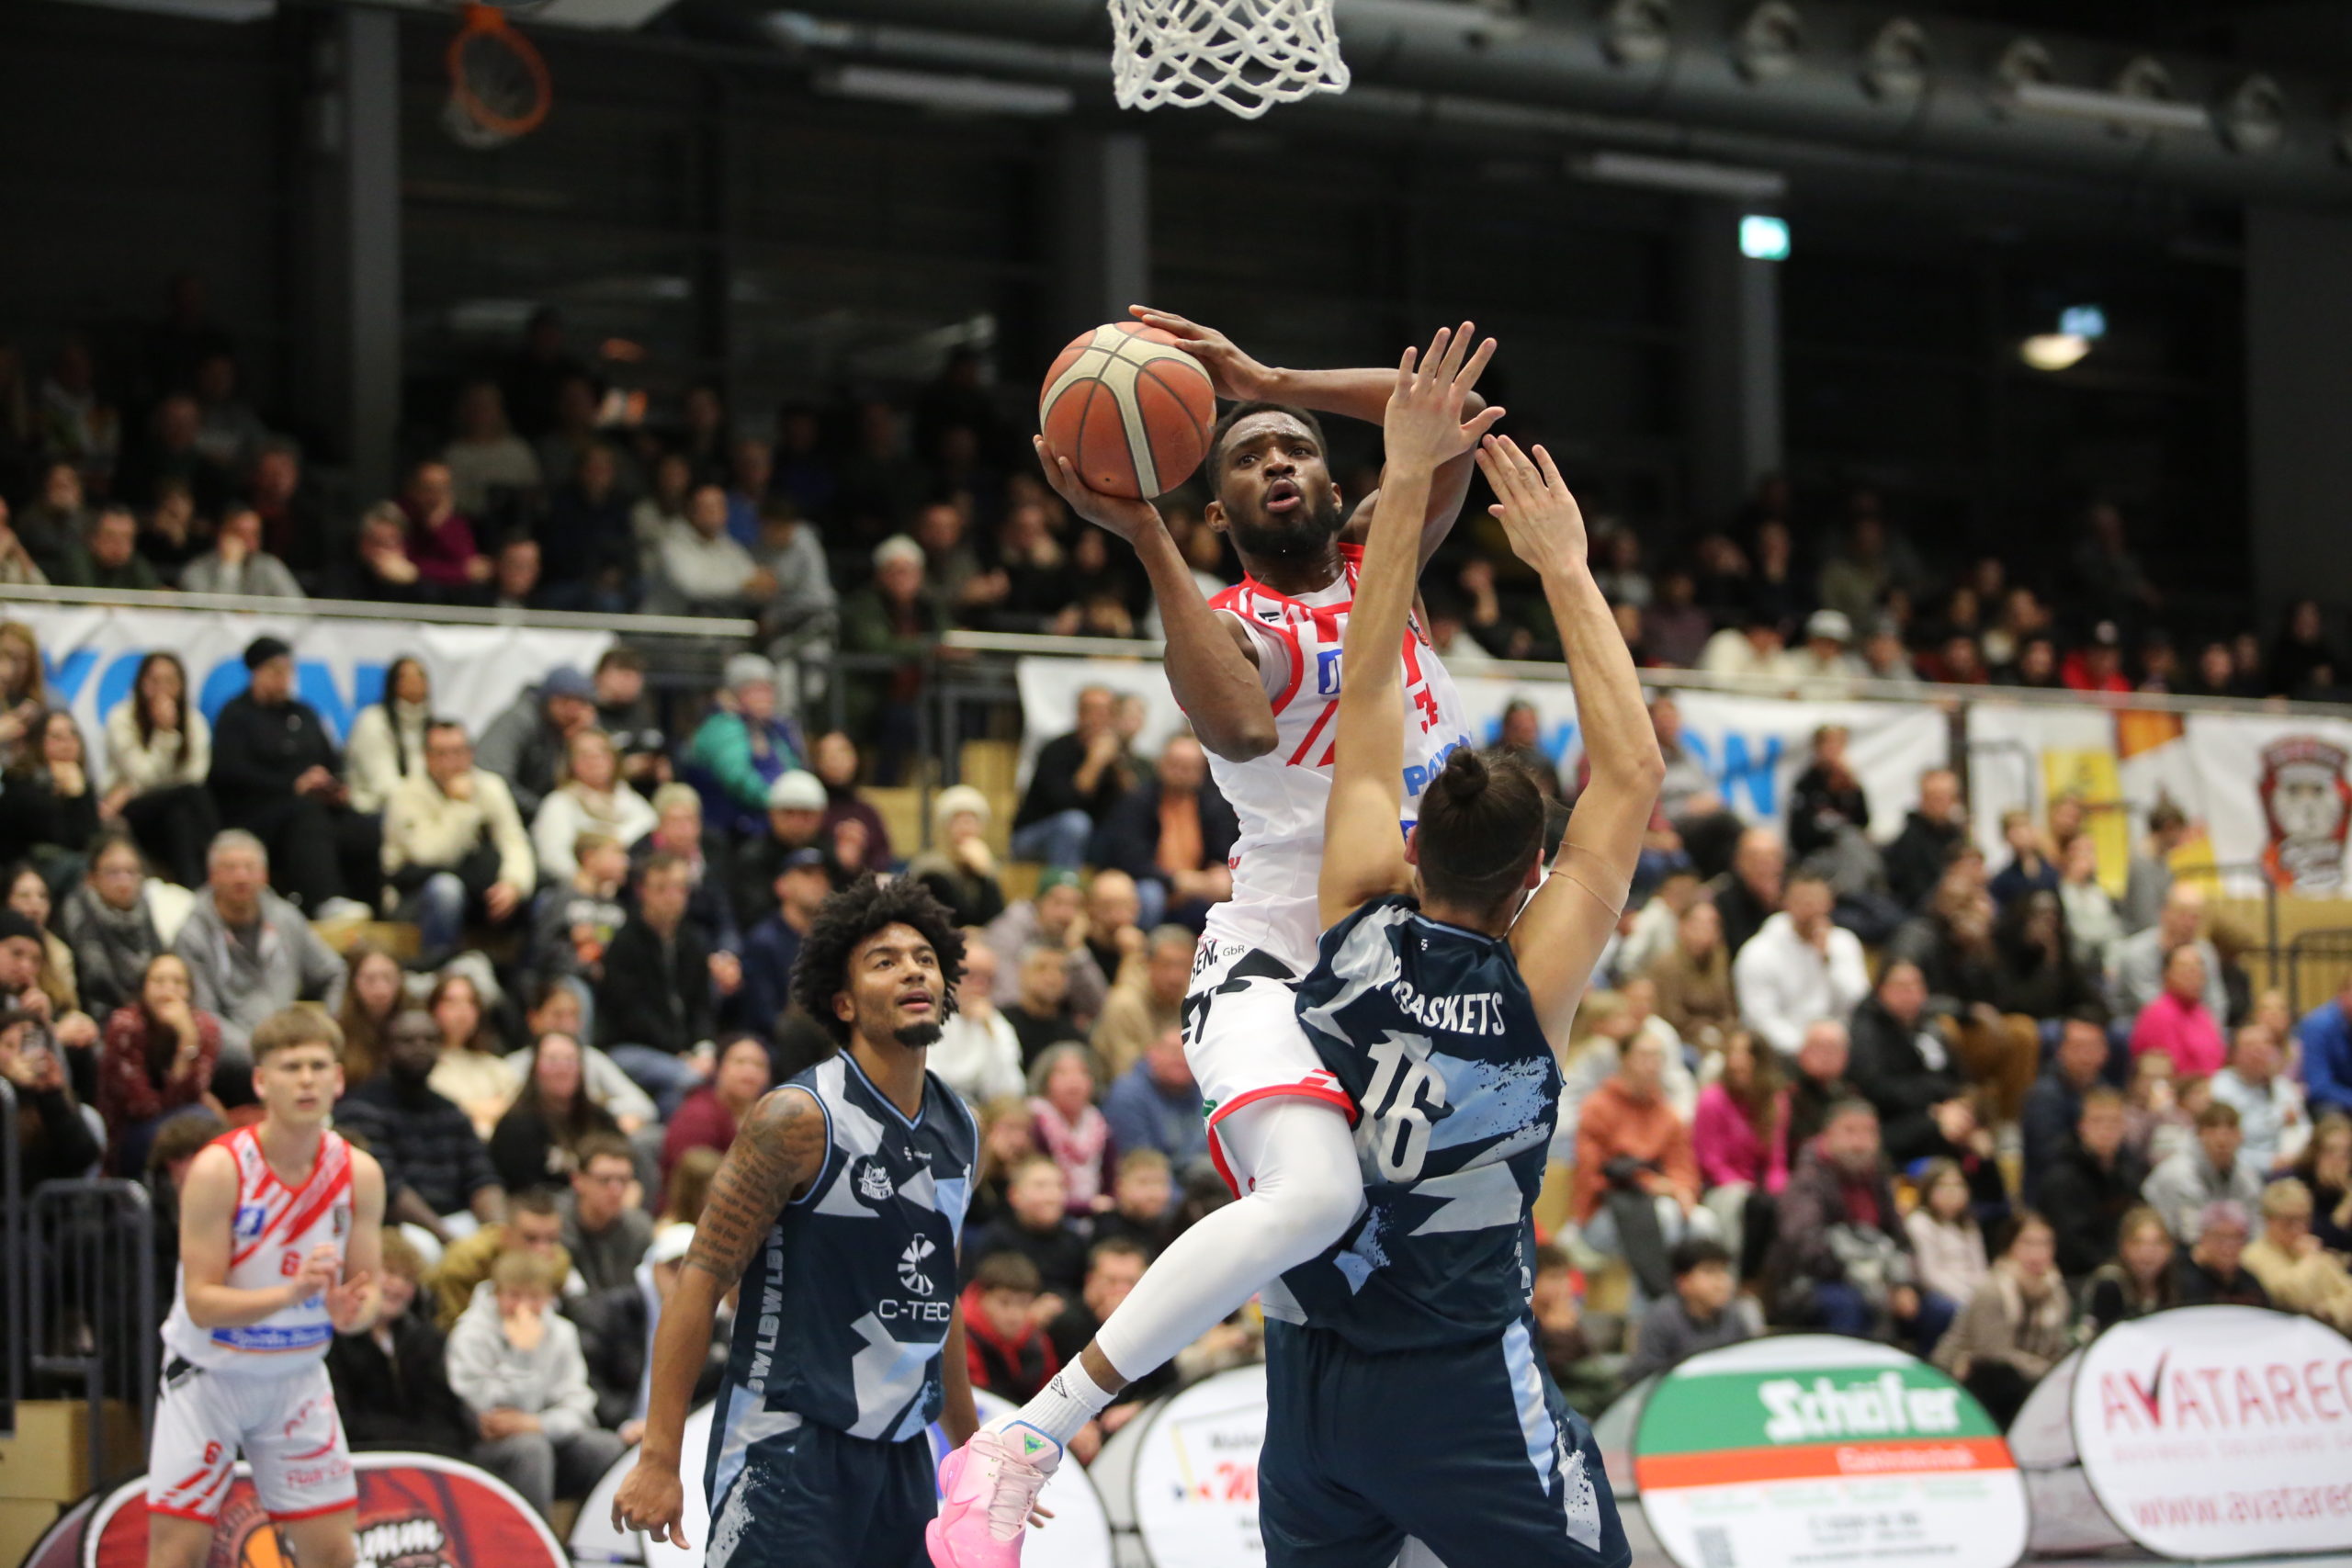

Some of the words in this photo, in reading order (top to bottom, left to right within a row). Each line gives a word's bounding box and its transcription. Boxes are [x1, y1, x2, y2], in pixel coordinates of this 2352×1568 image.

[1222, 944, 1246, 957] GbR
[1391, 980, 1506, 1036] BASKETS
[1360, 1036, 1447, 1183] 16
[878, 1299, 950, 1322] C-TEC
